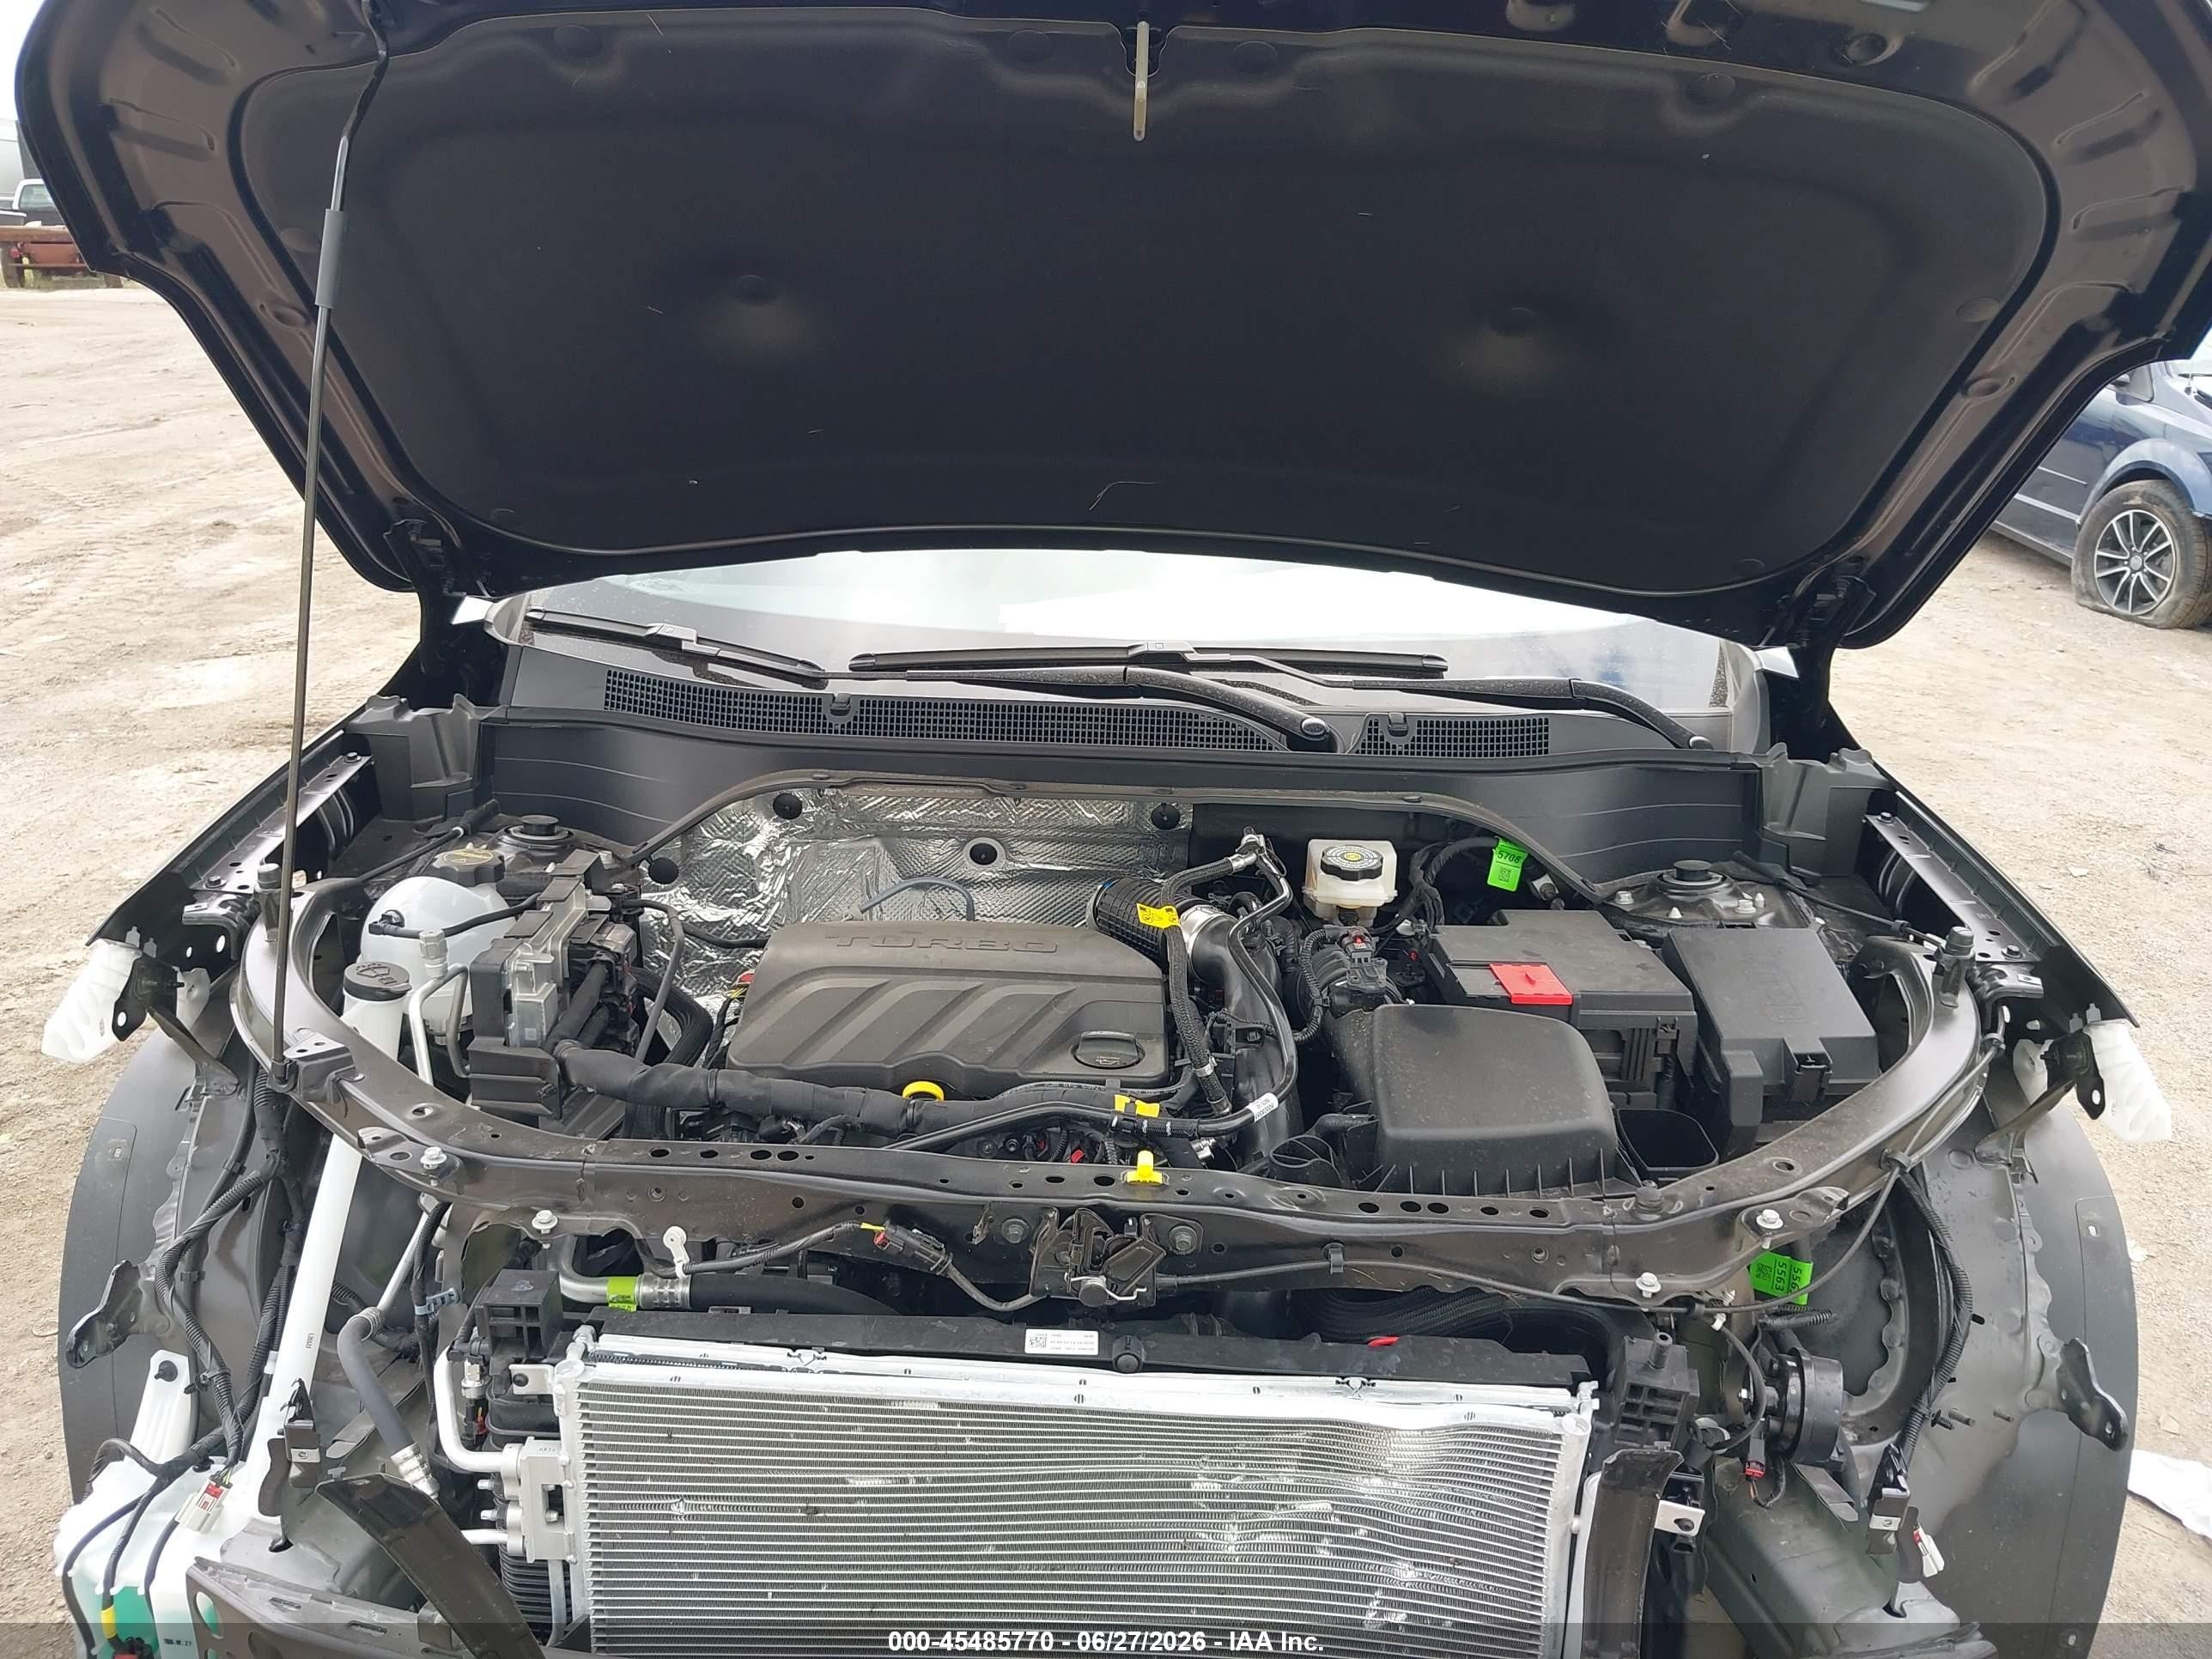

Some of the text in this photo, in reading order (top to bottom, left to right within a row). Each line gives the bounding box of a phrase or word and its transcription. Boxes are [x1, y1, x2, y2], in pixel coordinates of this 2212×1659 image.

[1497, 850, 1522, 864] 5708
[824, 933, 1059, 953] TURBO
[1775, 1261, 1787, 1291] 5563
[1790, 1266, 1802, 1292] 556
